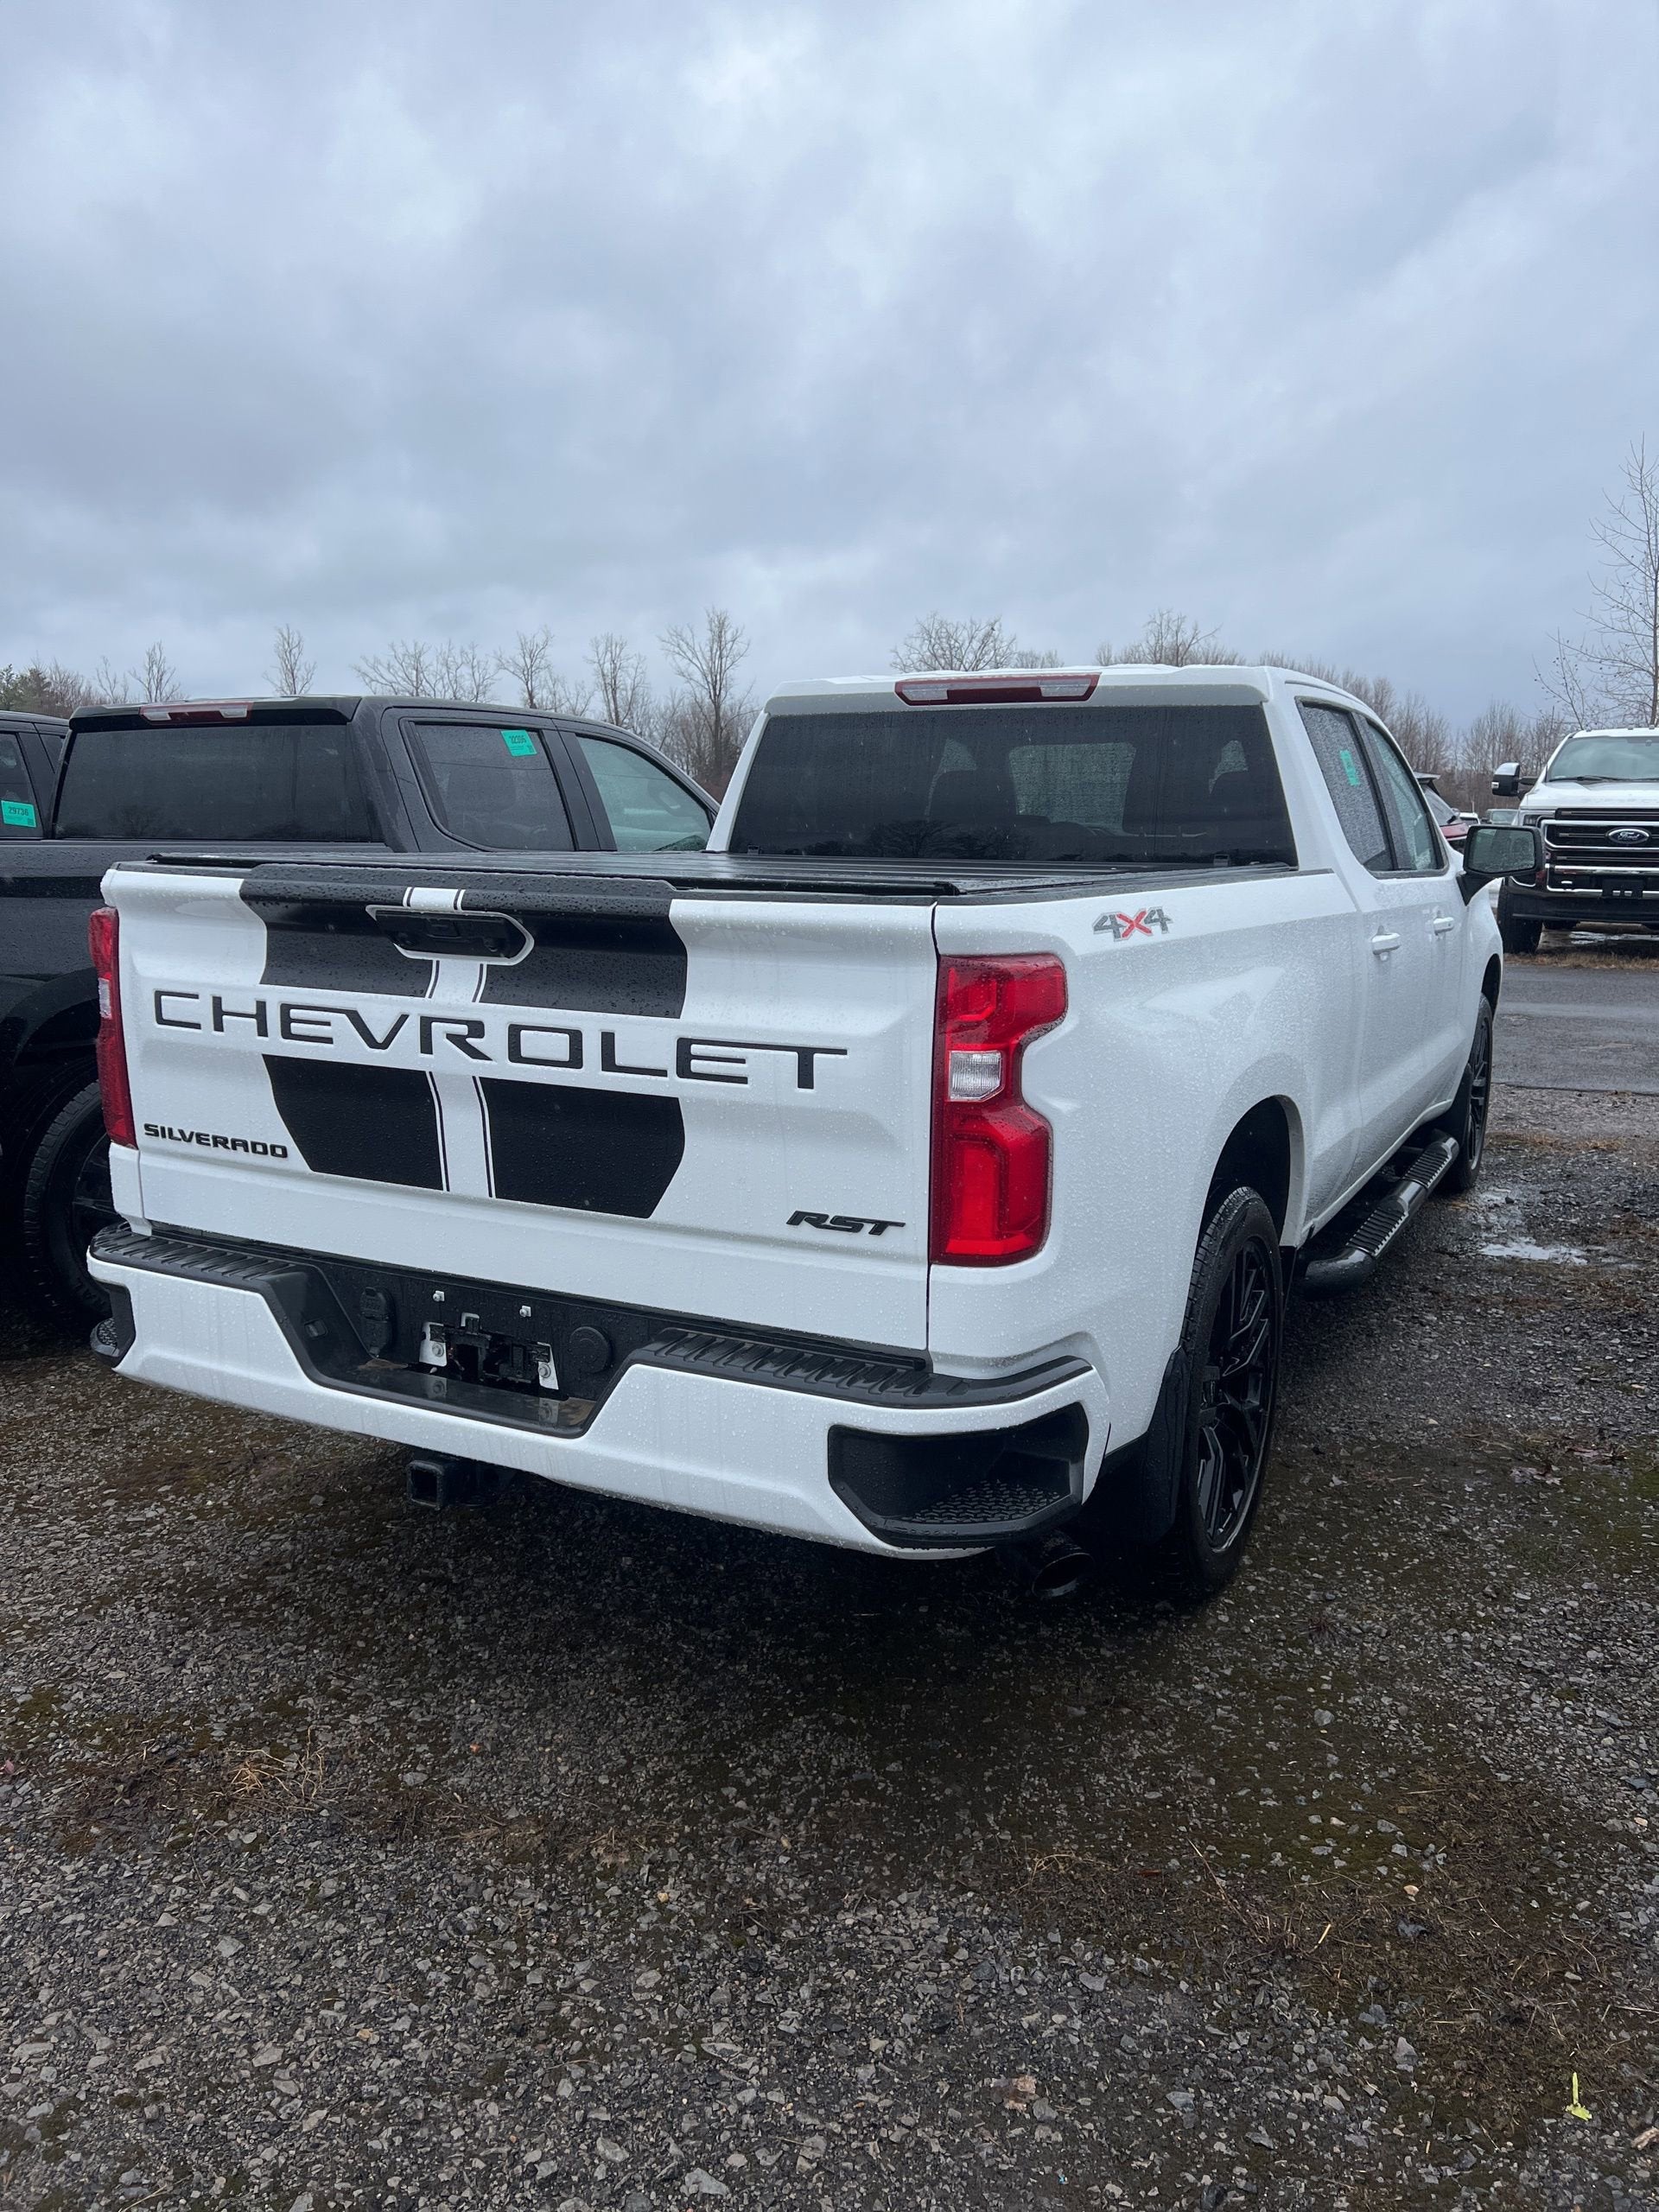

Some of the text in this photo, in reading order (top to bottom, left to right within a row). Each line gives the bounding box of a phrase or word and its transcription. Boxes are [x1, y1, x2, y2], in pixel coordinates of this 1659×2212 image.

[154, 989, 848, 1090] CHEVROLET
[143, 1122, 288, 1159] SILVERADO
[786, 1210, 906, 1236] RST
